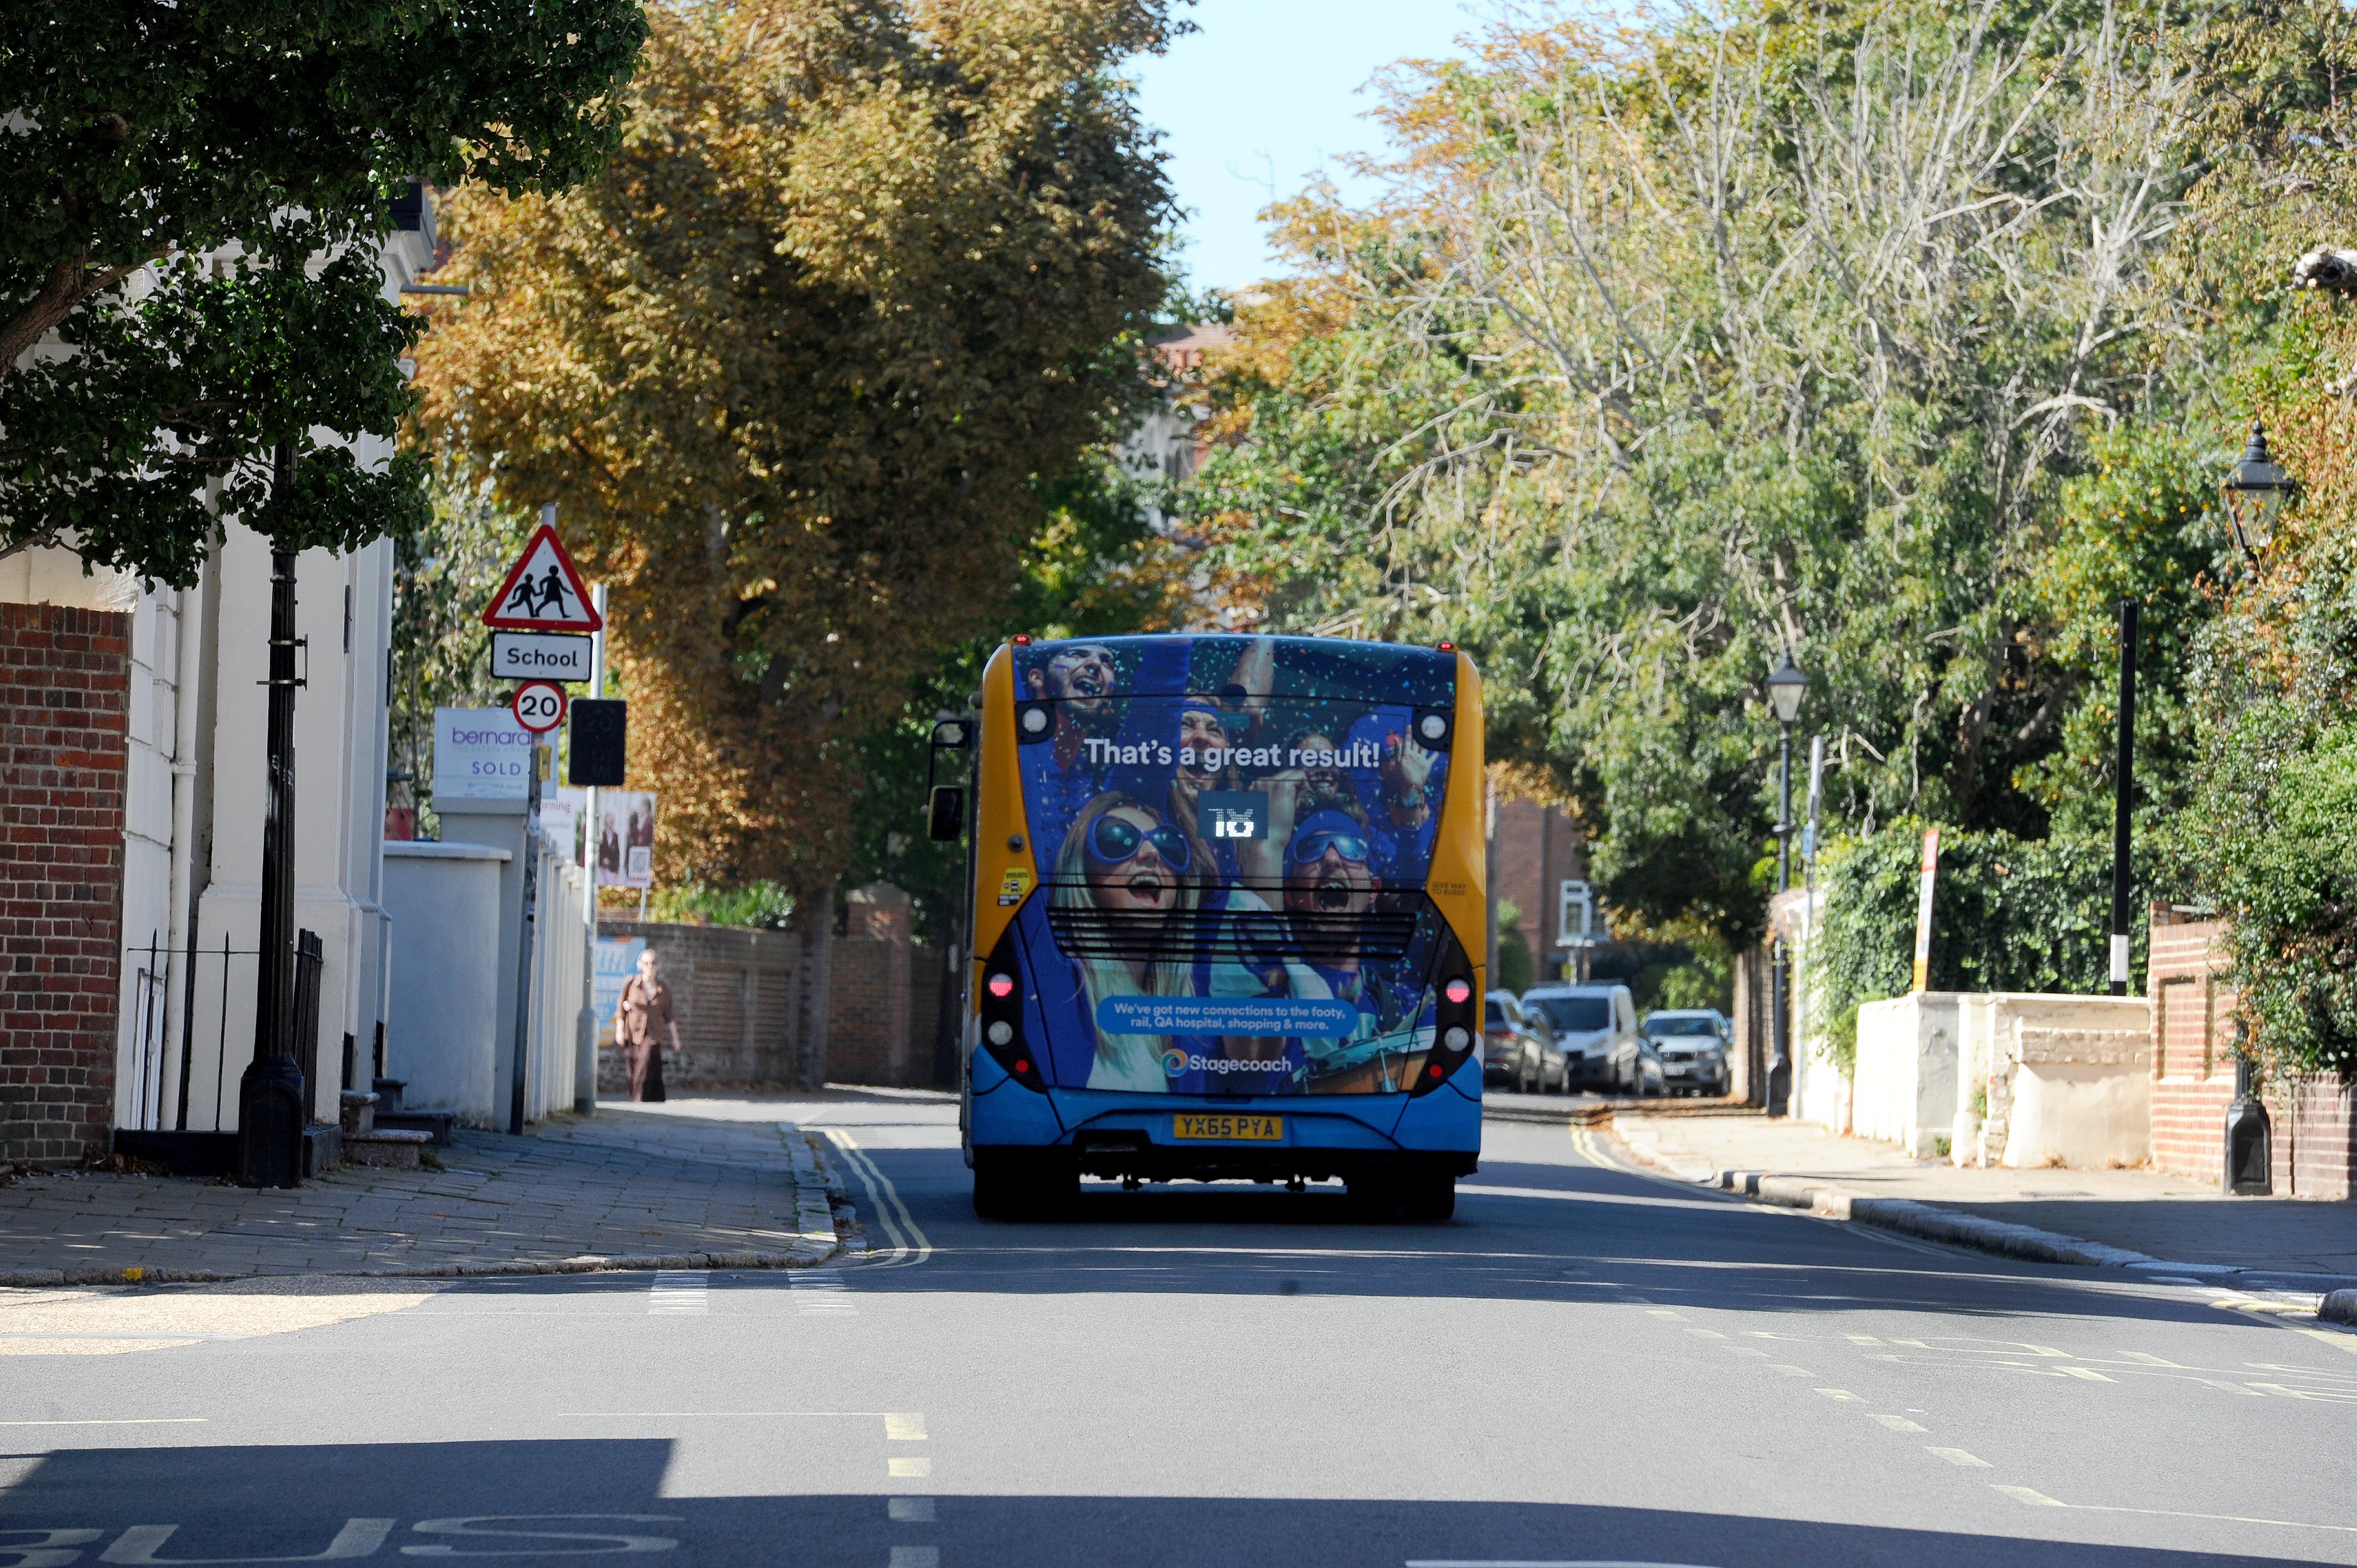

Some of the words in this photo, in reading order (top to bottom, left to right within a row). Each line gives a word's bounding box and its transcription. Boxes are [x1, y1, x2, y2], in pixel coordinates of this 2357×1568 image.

[507, 647, 578, 667] School
[521, 695, 557, 717] 20
[1083, 738, 1172, 765] That's
[1180, 746, 1196, 765] a
[1203, 744, 1282, 772] great
[1289, 742, 1380, 768] result!
[472, 761, 521, 776] SOLD
[1114, 1003, 1151, 1014] We've
[1153, 1004, 1172, 1017] got
[1175, 1006, 1200, 1015] new
[1202, 1005, 1273, 1016] connections
[1276, 1007, 1288, 1017] to
[1290, 1005, 1309, 1017] the
[1311, 1006, 1346, 1019] footy,
[1130, 1016, 1152, 1029] rail,
[1154, 1017, 1174, 1028] QA
[1175, 1017, 1224, 1030] hospital,
[1228, 1018, 1281, 1031] shopping
[1284, 1019, 1292, 1030] &
[1295, 1021, 1329, 1030] more.
[1190, 1055, 1292, 1075] Stagecoach
[1183, 1117, 1232, 1135] YX65
[1237, 1118, 1274, 1136] PYA
